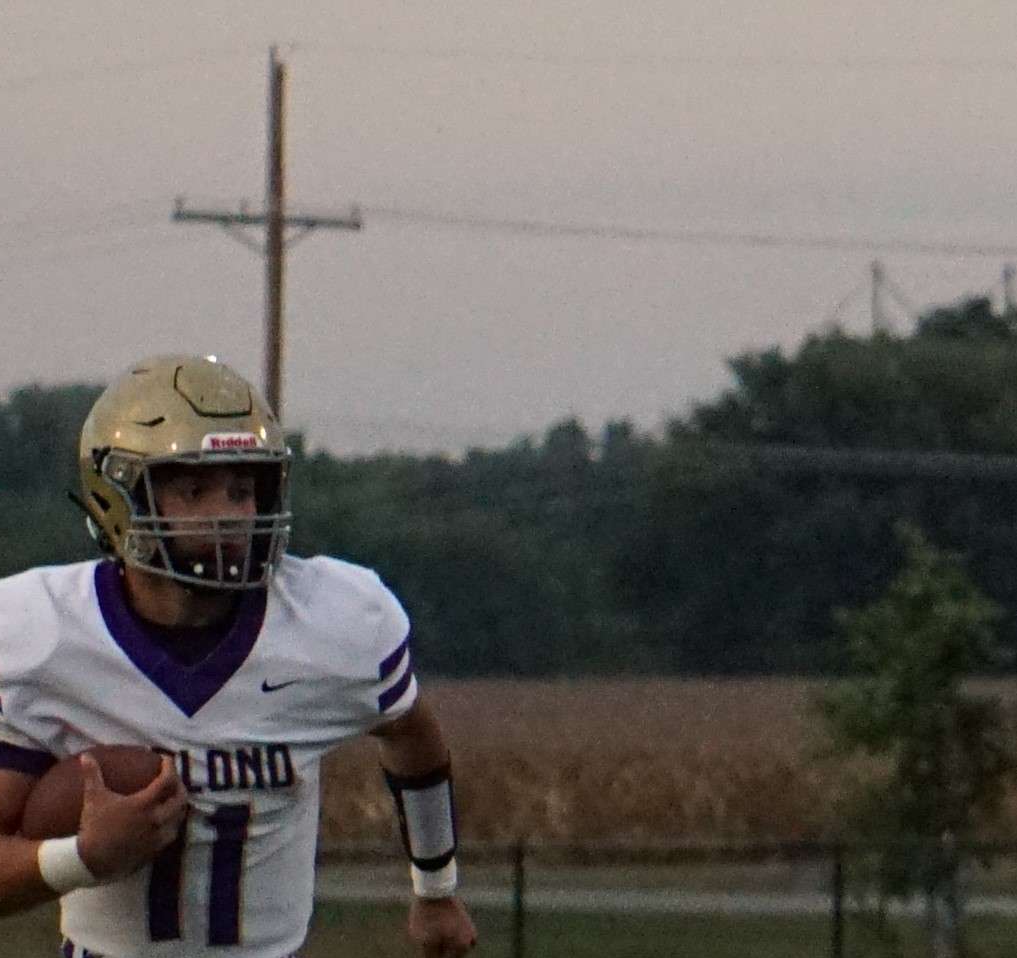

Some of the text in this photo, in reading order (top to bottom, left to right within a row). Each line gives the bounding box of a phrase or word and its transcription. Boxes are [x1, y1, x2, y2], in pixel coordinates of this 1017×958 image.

[210, 436, 257, 449] Riddell
[151, 742, 295, 793] LOND
[147, 803, 250, 946] 11
